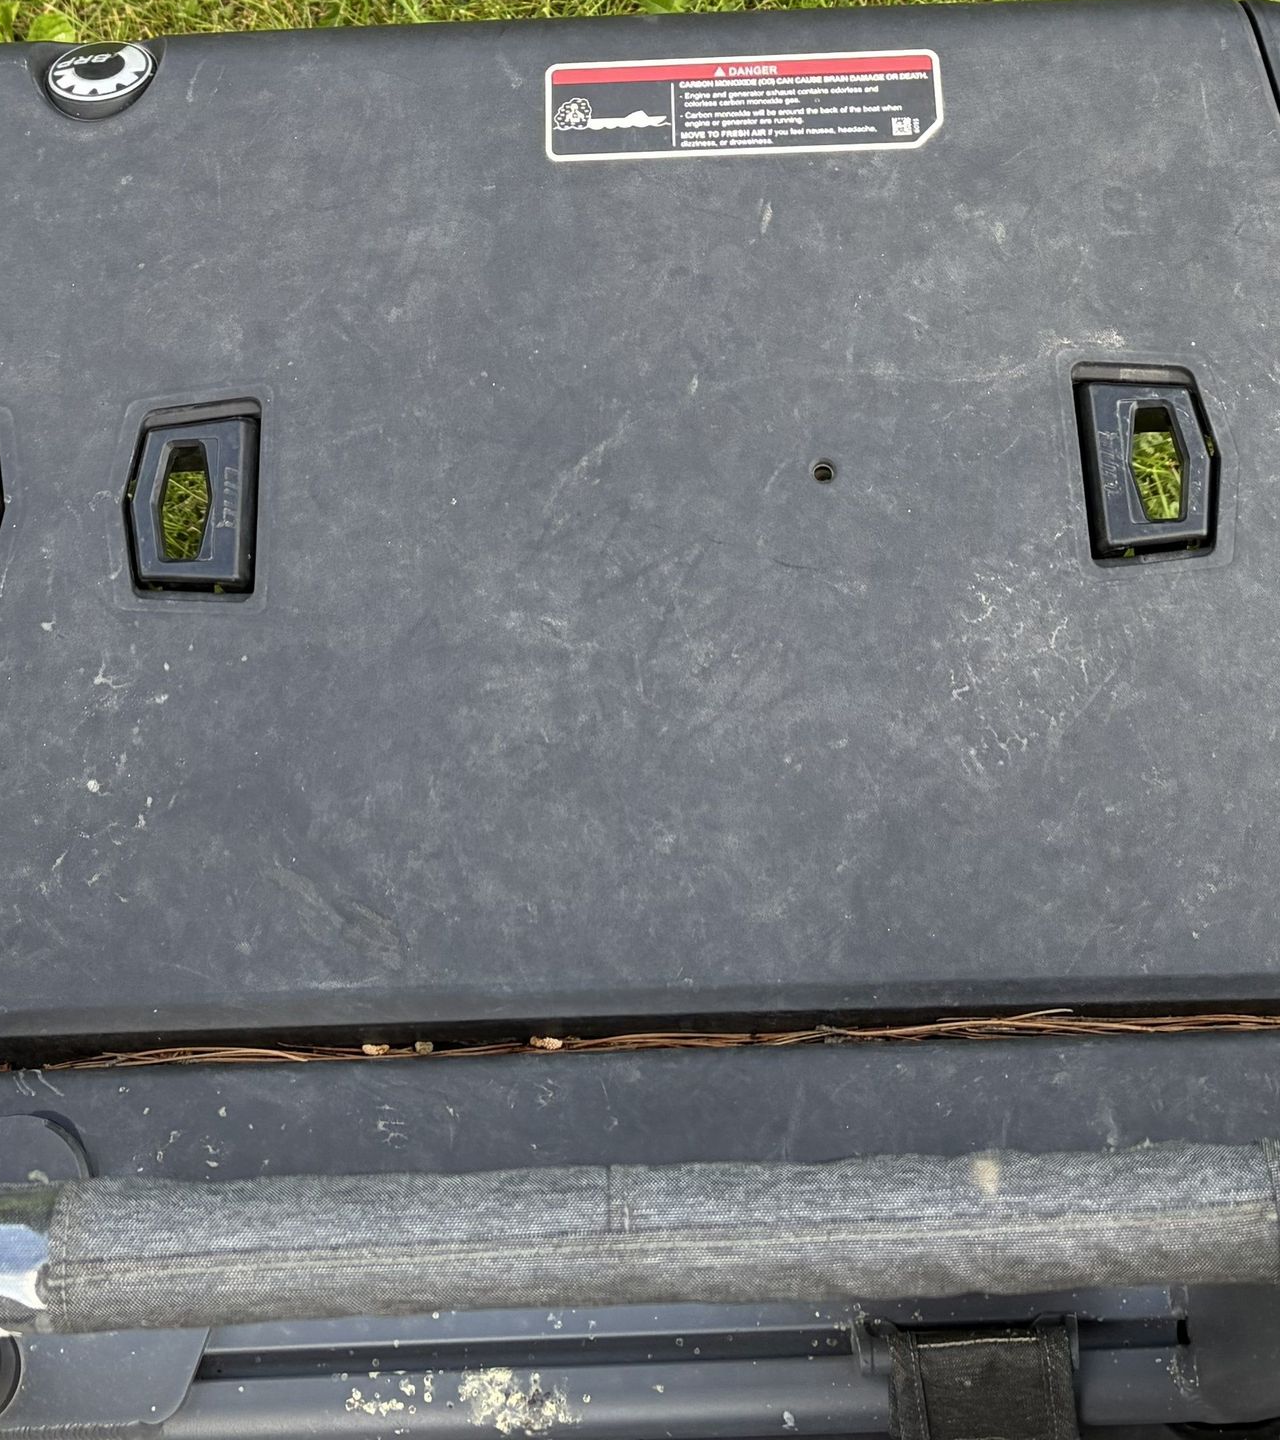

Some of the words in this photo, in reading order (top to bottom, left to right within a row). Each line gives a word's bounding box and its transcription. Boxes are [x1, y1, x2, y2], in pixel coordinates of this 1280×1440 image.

[57, 53, 112, 69] BRP
[728, 65, 778, 76] DANGER
[679, 80, 714, 88] CARBON
[714, 78, 757, 87] MONOXIDE
[758, 78, 775, 87] (CO)
[776, 77, 794, 85] CAN
[795, 75, 822, 84] CAUSE
[823, 74, 848, 83] BRAIN
[850, 73, 885, 82] DAMAGE
[886, 73, 898, 81] OR
[899, 72, 928, 80] DEATH.
[684, 92, 711, 101] Engine
[728, 90, 764, 99] generator
[830, 86, 863, 94] odorless
[864, 85, 879, 93] and
[718, 99, 745, 107] carbon
[785, 97, 800, 105] gas.
[685, 111, 713, 119] Carbon
[766, 108, 776, 116] be
[778, 107, 804, 115] around
[806, 106, 818, 114] the
[820, 106, 838, 114] back
[840, 105, 848, 113] of
[849, 105, 861, 113] the
[881, 104, 903, 112] when
[684, 120, 710, 128] engine
[721, 118, 758, 127] generator
[774, 116, 804, 124] running.
[681, 131, 706, 139] MOVE
[721, 129, 750, 137] FRESH
[774, 129, 788, 137] you
[790, 127, 805, 135] feel
[680, 140, 718, 148] dizziness,
[729, 138, 773, 146] drowsiness.
